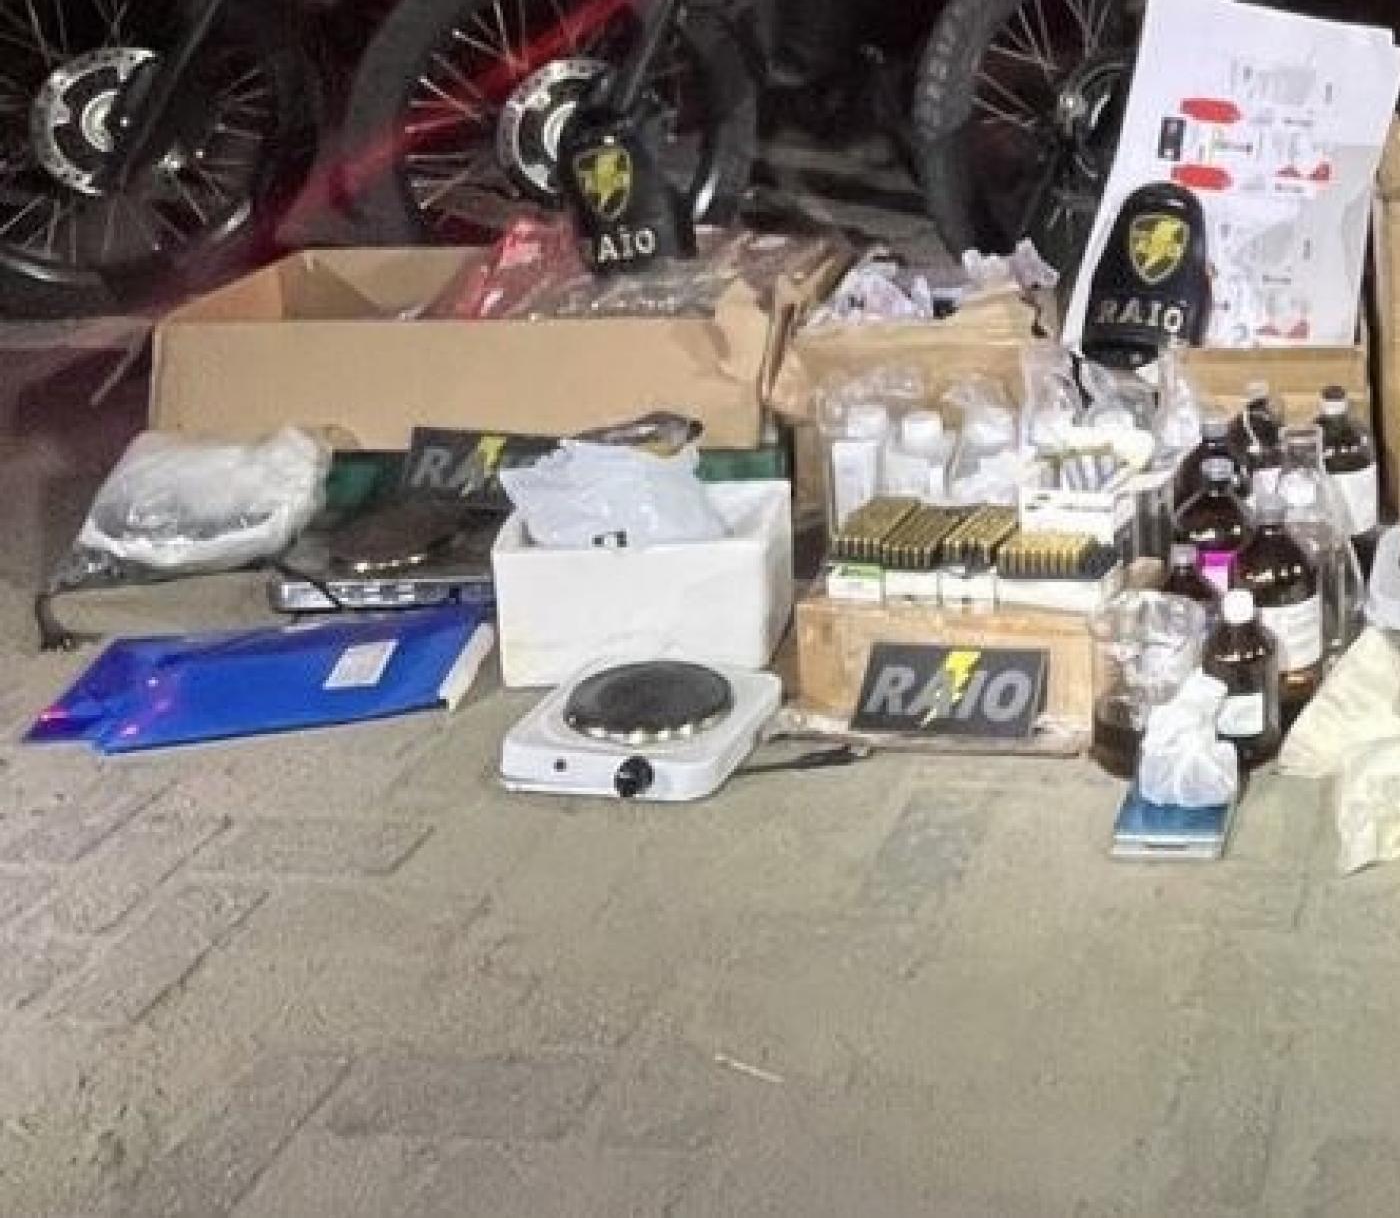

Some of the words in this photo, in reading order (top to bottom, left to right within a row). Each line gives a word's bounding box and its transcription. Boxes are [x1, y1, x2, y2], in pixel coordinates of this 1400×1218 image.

[597, 228, 656, 263] AIO
[1096, 297, 1184, 333] RAIO
[863, 663, 1033, 723] RAIO
